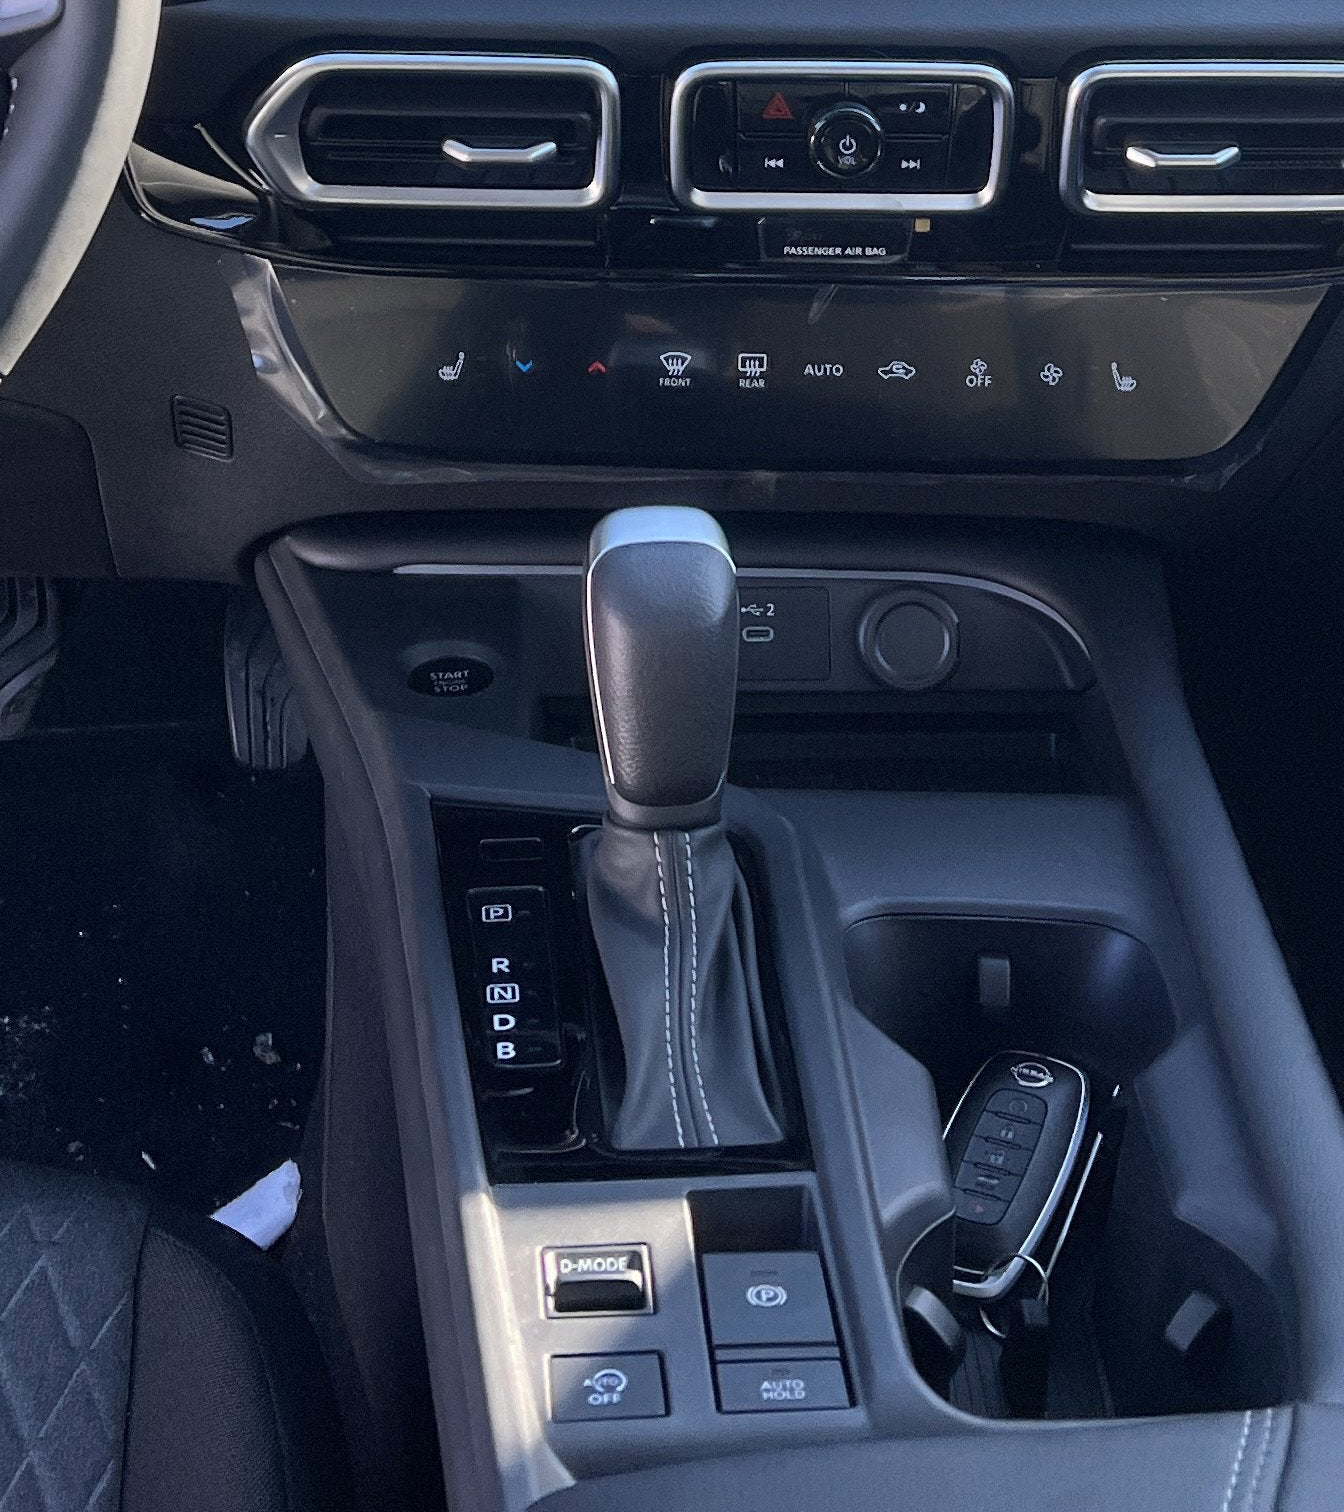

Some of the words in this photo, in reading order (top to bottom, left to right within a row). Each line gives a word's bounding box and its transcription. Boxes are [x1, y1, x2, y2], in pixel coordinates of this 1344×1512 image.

[783, 246, 842, 256] PASSENGER
[844, 246, 863, 256] AIR
[865, 246, 887, 256] BAG
[804, 363, 843, 377] AUTO
[659, 377, 692, 388] FRONT
[739, 377, 765, 388] REAR
[965, 375, 992, 388] OFF
[766, 603, 775, 616] 2
[429, 669, 469, 680] START
[434, 684, 468, 693] STOP
[489, 907, 503, 920] P
[492, 958, 510, 973] R
[494, 987, 512, 1000] N
[493, 1014, 516, 1031] D
[497, 1042, 516, 1059] B
[560, 1256, 628, 1274] D-MODE
[760, 1378, 804, 1390] AUTO
[587, 1392, 621, 1405] OFF
[763, 1389, 805, 1401] HOLD
